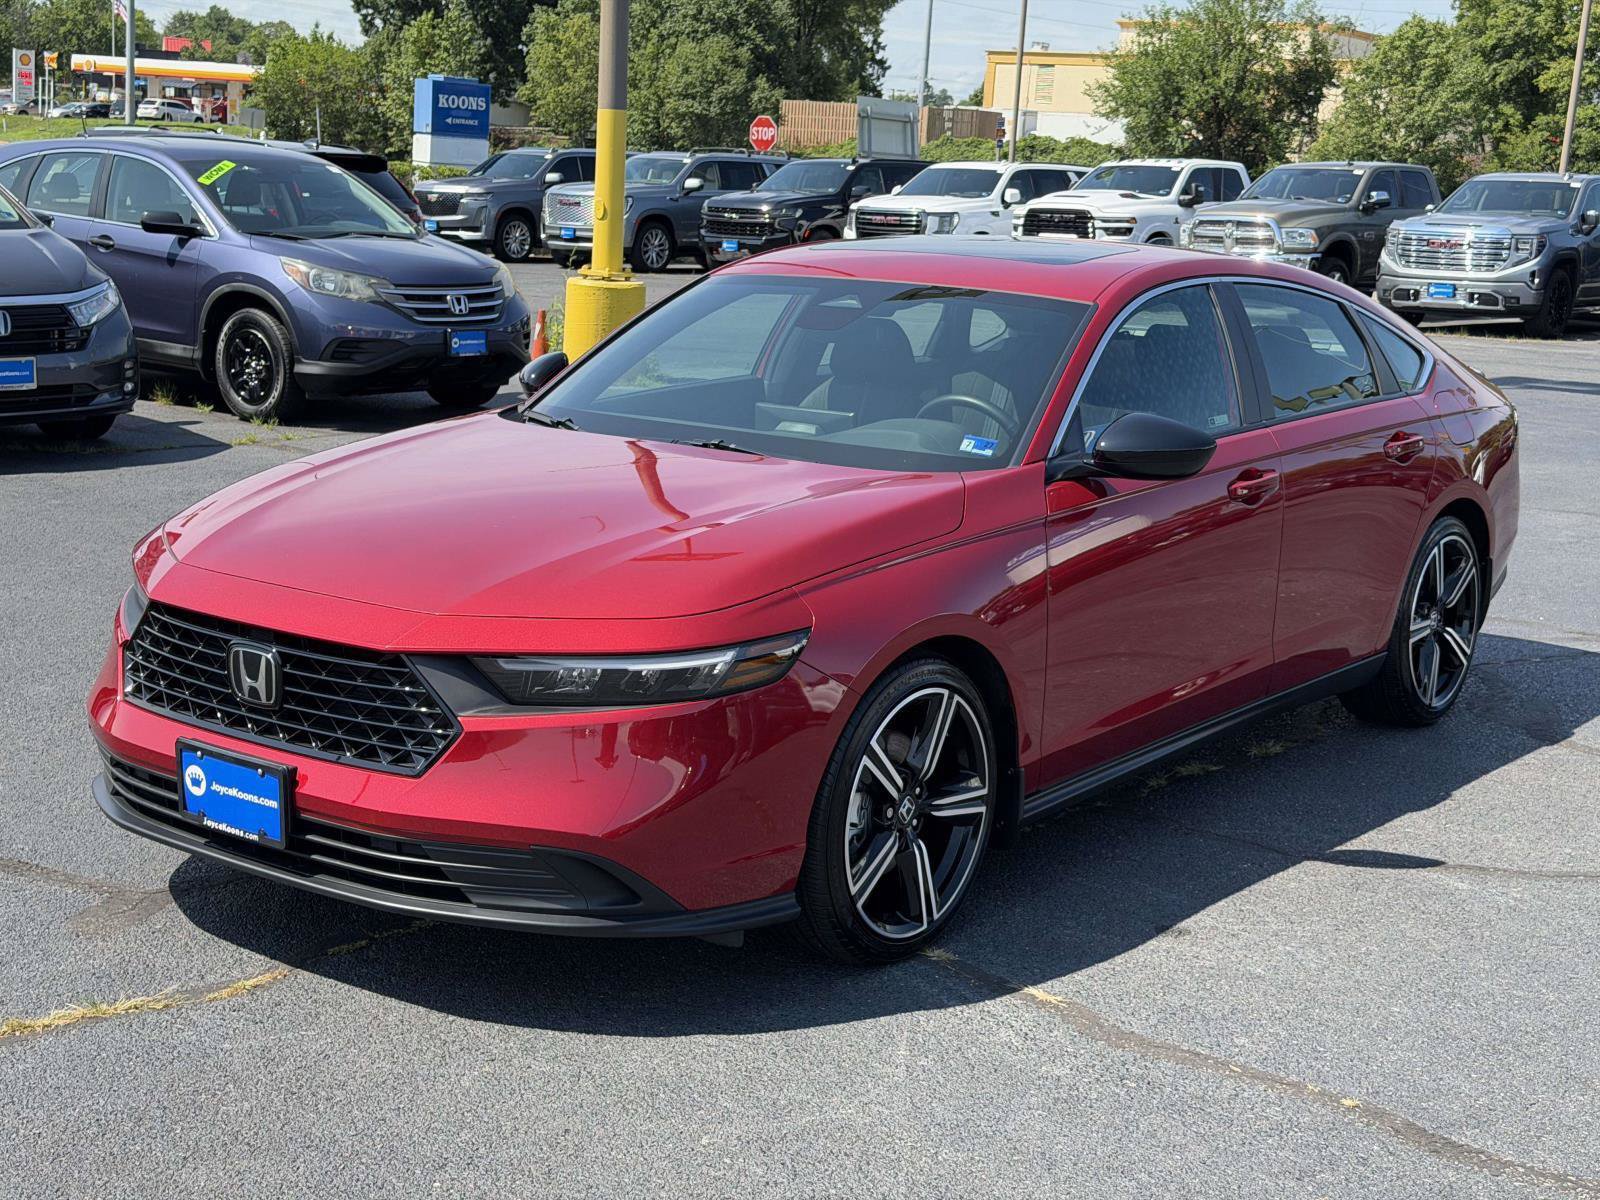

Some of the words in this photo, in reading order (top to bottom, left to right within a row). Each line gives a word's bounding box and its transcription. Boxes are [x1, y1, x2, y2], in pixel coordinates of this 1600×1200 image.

[438, 94, 487, 111] KOONS
[452, 118, 479, 126] ENTRANCE
[751, 126, 775, 141] STOP
[210, 781, 278, 809] JoyceKoons.com
[202, 816, 259, 841] JoyceKoons.com
